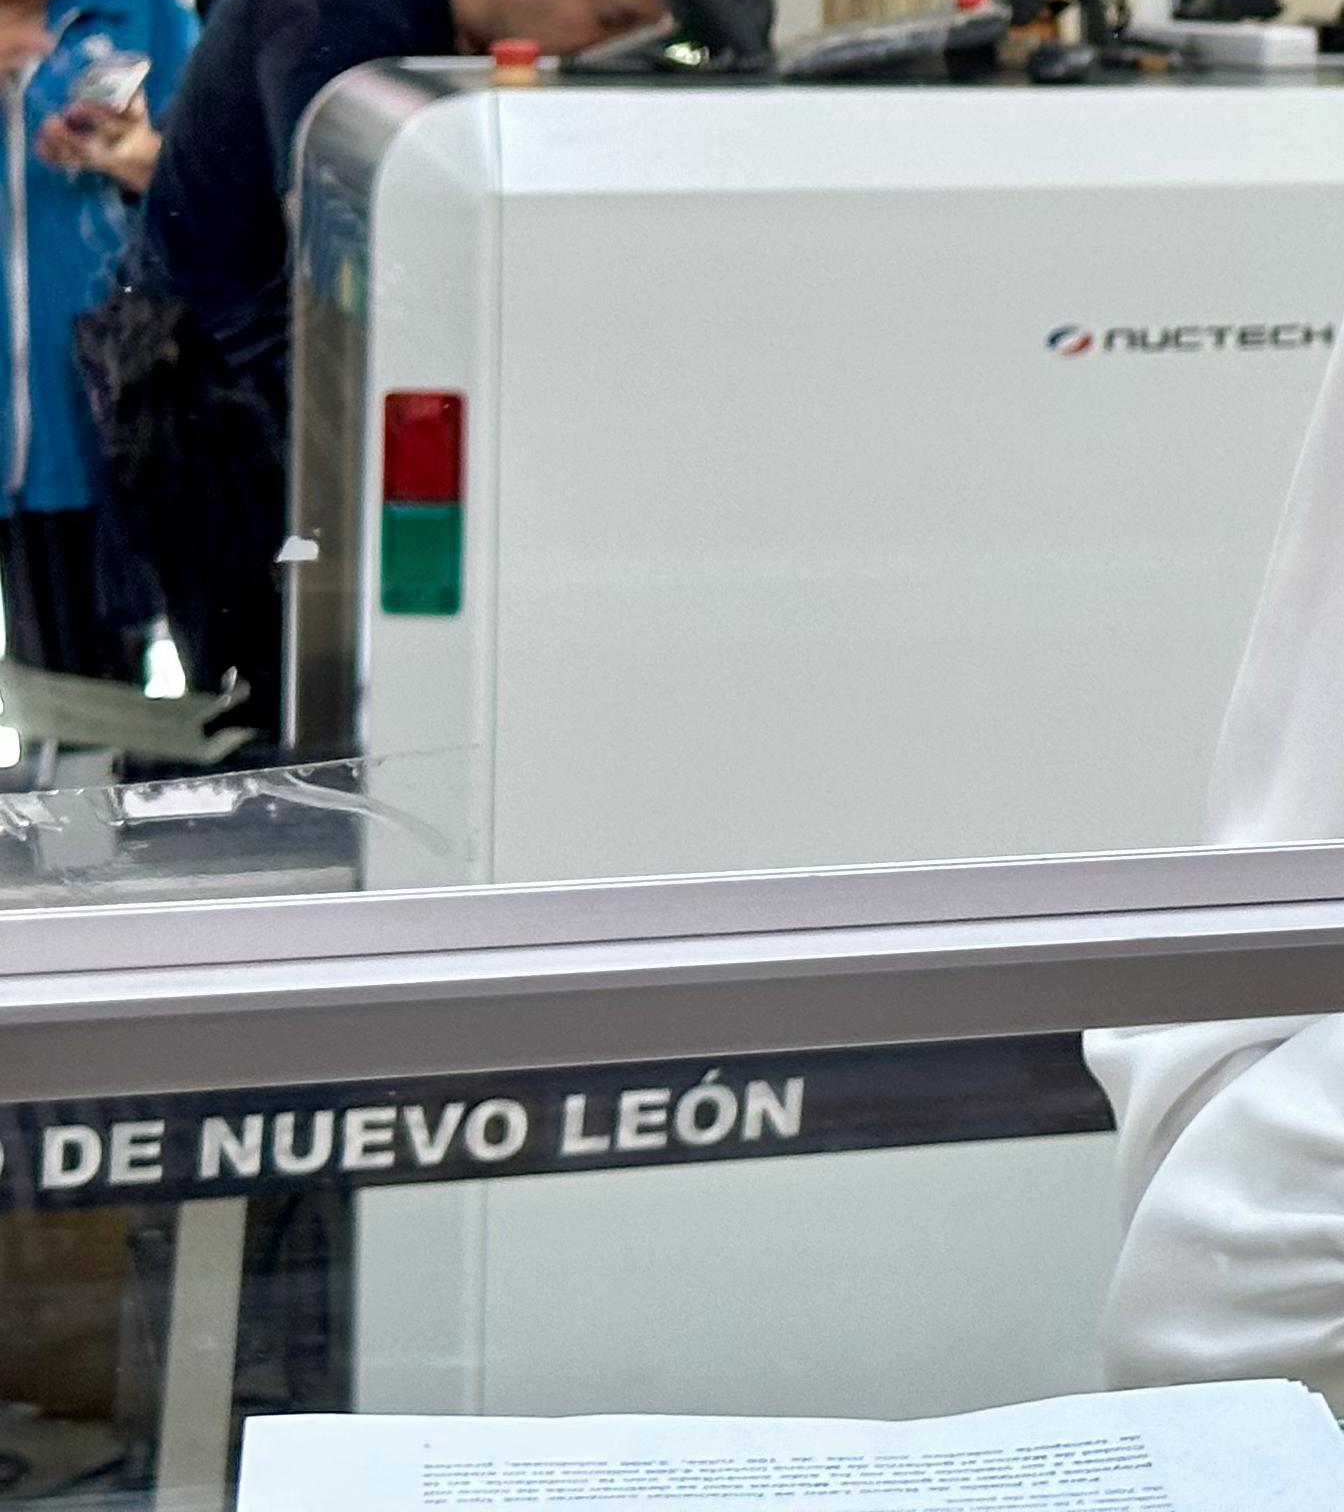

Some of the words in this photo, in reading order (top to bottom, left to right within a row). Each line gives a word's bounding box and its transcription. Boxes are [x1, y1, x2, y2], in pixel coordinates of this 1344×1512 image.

[1104, 324, 1334, 351] NUCTECH
[41, 1120, 164, 1190] DE
[197, 1097, 528, 1182] NUEVO
[560, 1068, 806, 1158] LEÓN
